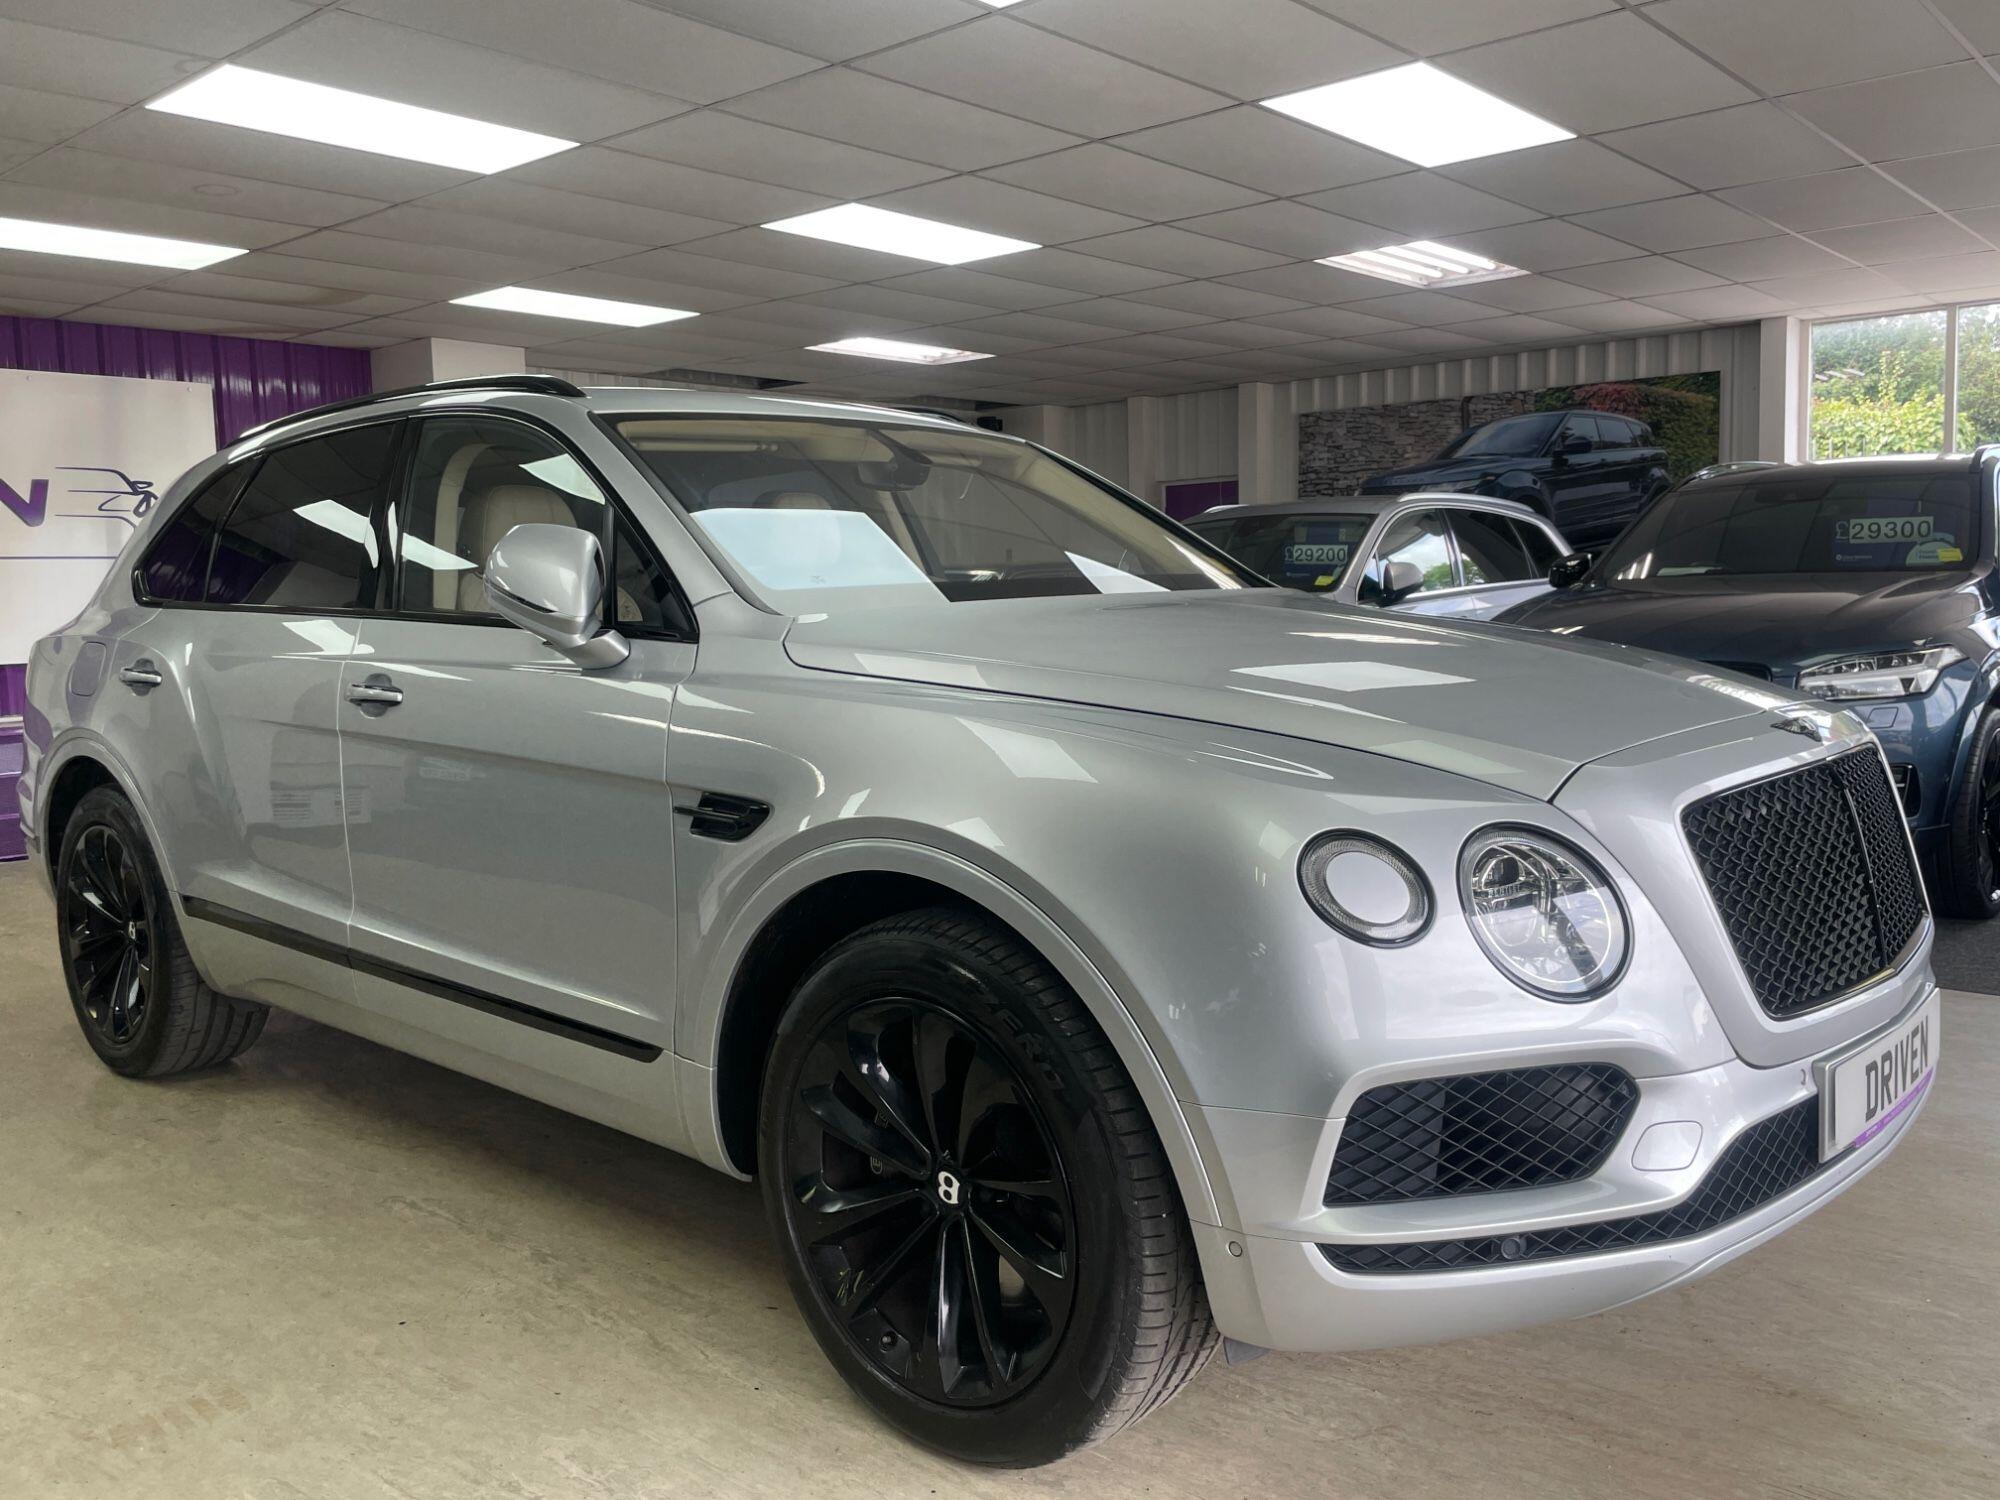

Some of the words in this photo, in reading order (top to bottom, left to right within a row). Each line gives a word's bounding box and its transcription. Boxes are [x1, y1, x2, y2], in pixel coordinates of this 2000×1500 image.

[1835, 519, 1932, 540] £29300
[1284, 546, 1346, 562] £29200
[1865, 1014, 1929, 1123] DRIVEN
